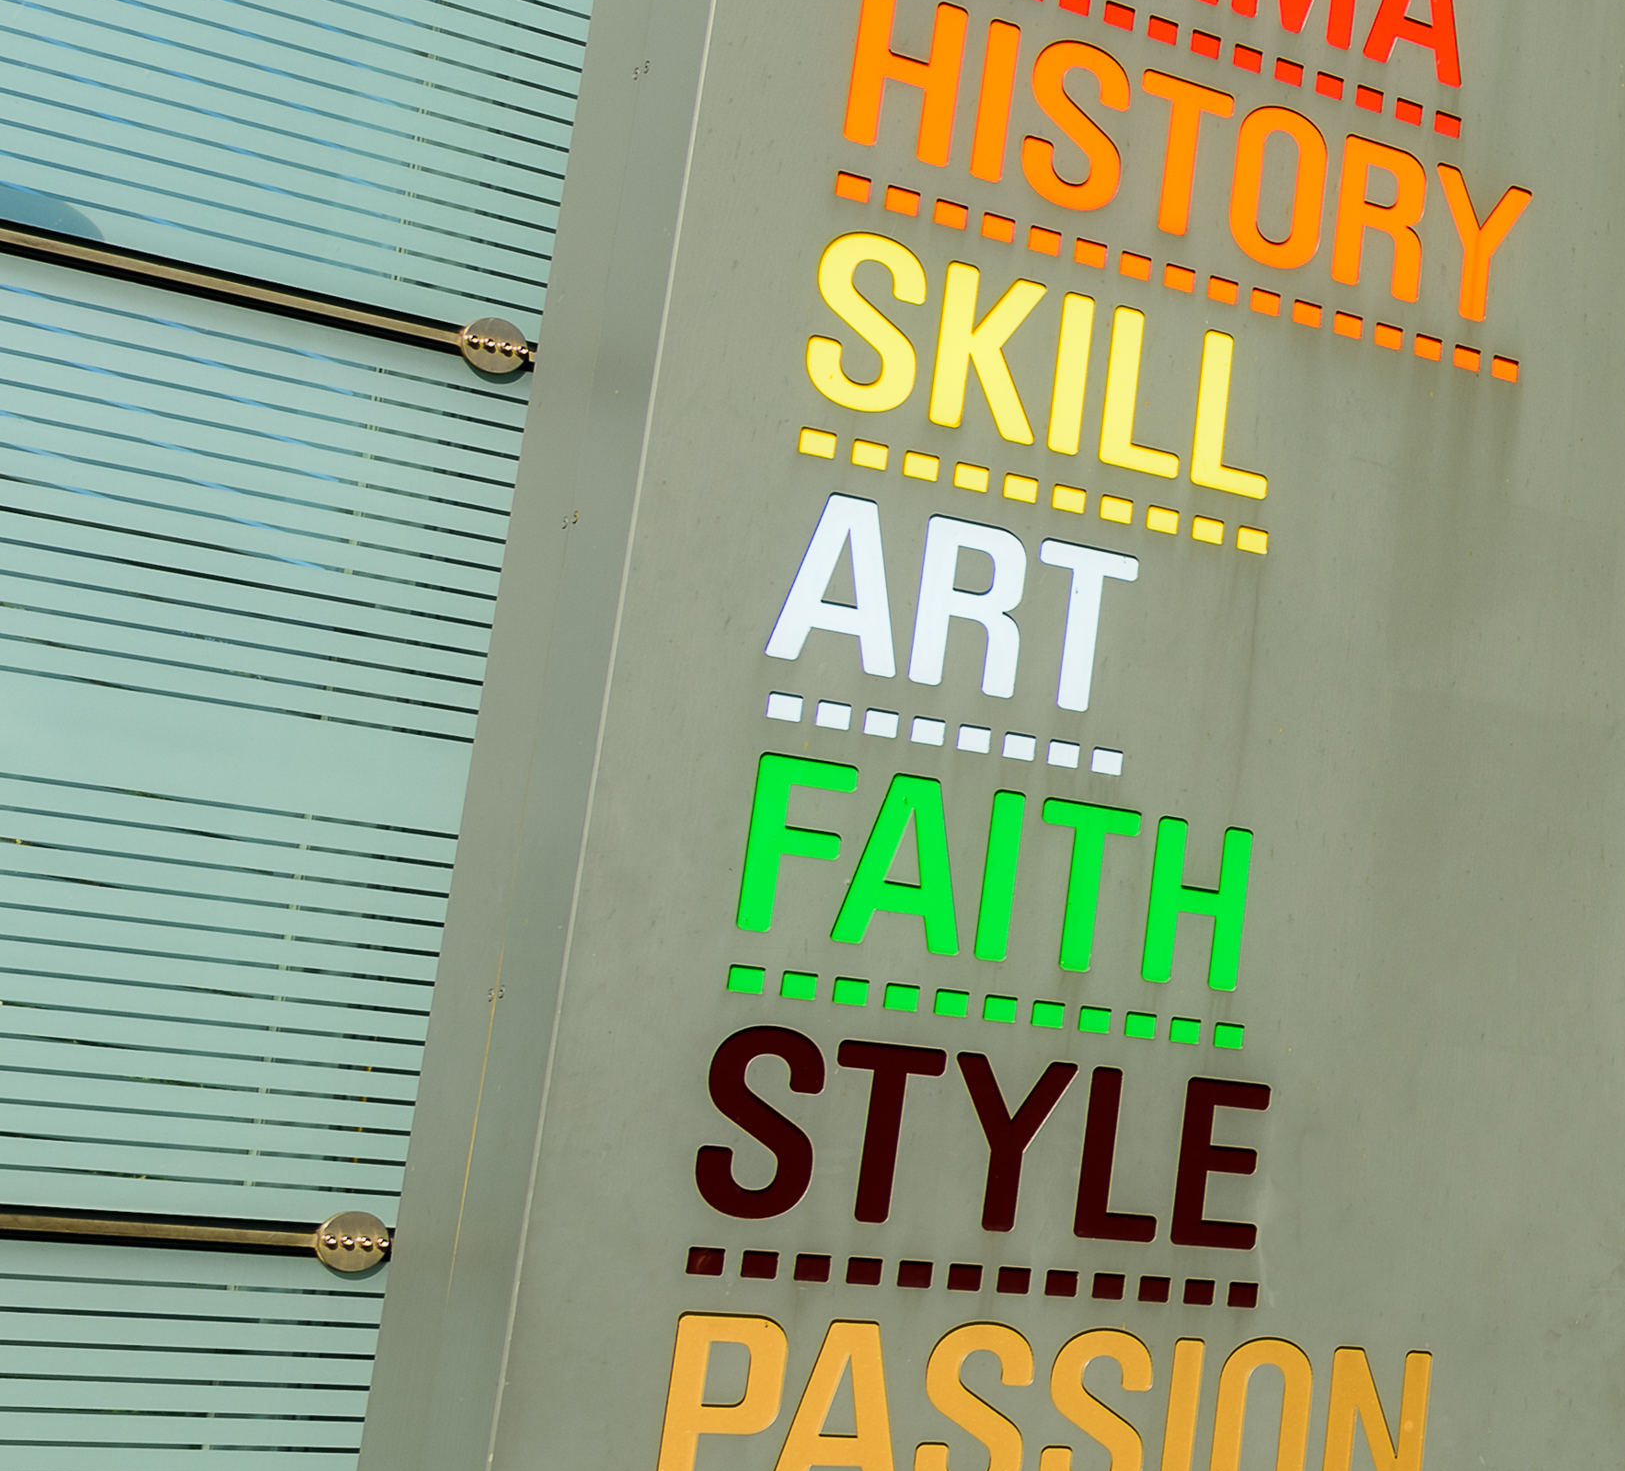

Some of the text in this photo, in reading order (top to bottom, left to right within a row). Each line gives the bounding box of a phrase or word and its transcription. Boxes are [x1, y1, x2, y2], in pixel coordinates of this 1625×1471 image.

[806, 231, 1268, 500] SKILL
[765, 492, 1140, 712] ART
[736, 752, 1255, 992] FAITH
[695, 1026, 1271, 1251] STYLE
